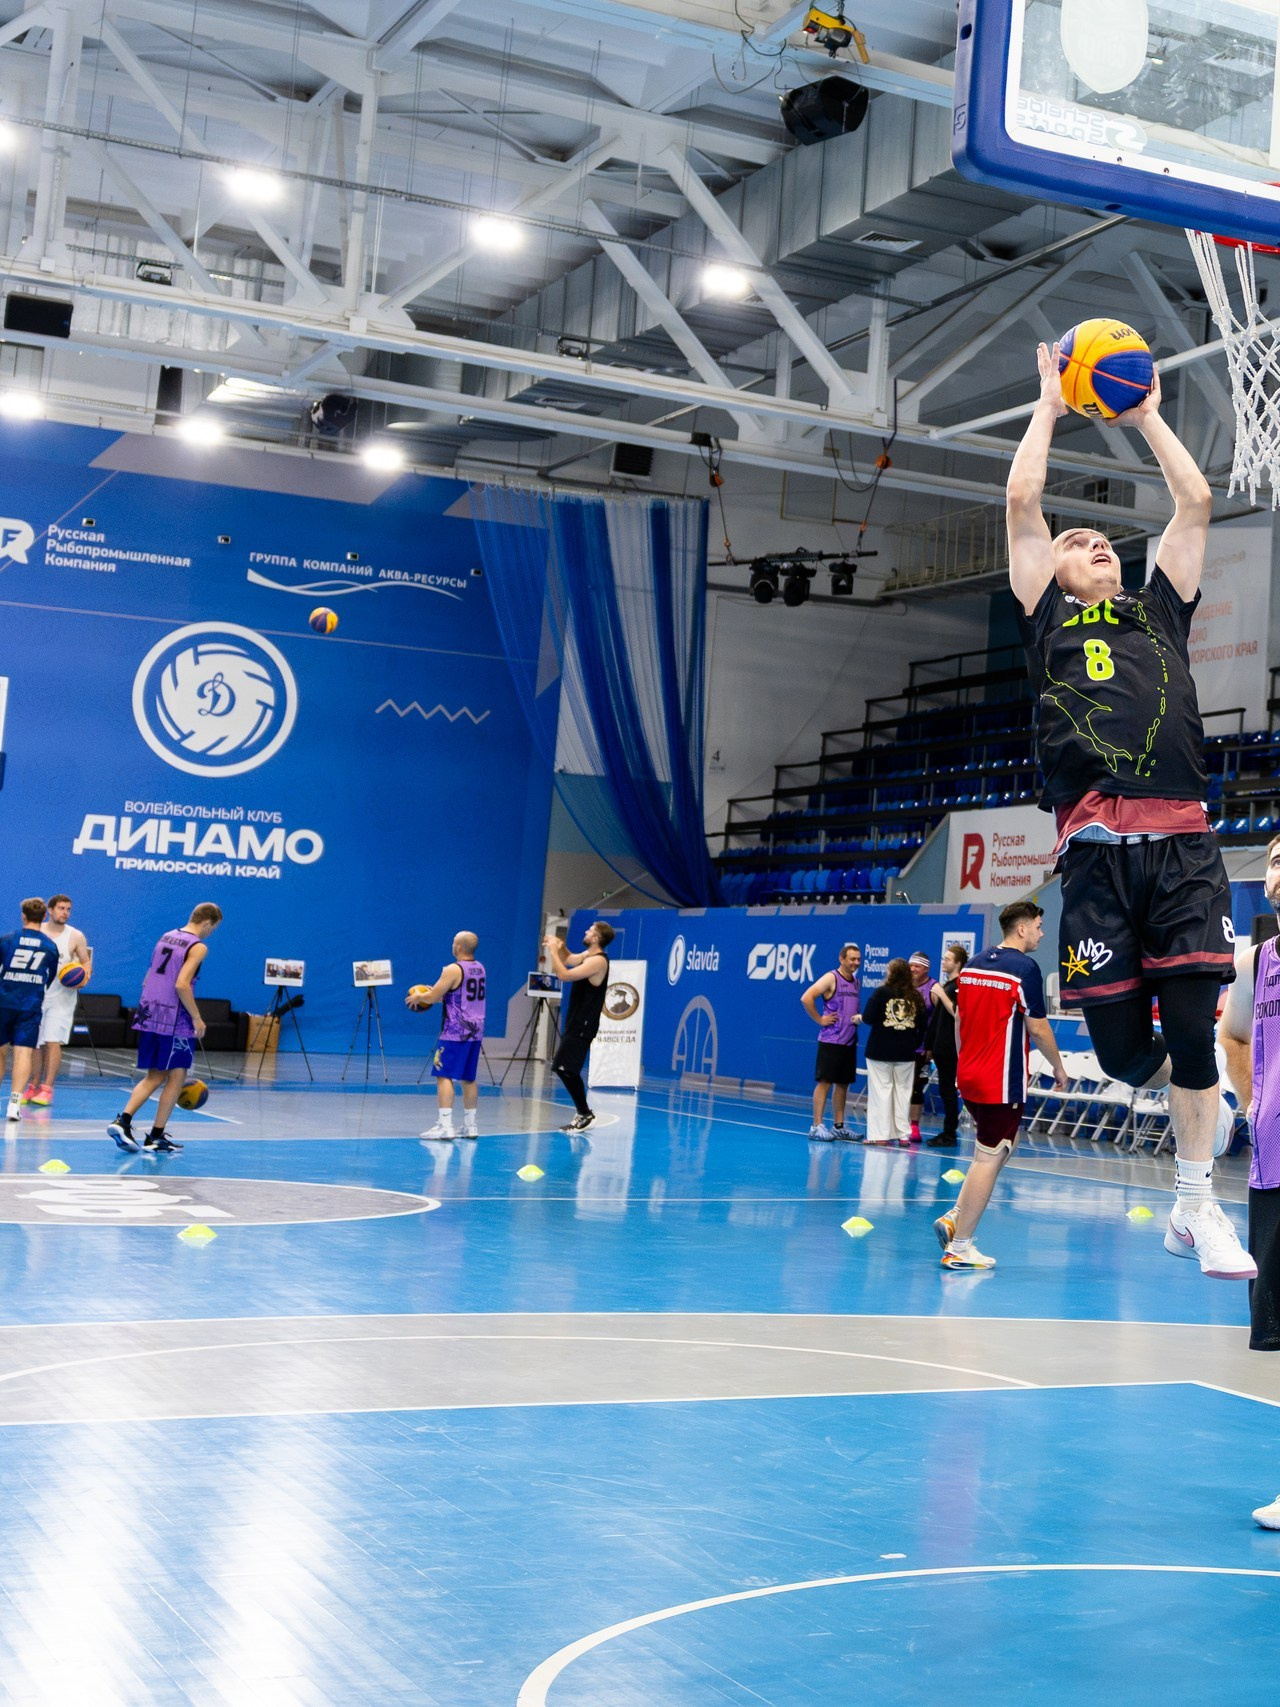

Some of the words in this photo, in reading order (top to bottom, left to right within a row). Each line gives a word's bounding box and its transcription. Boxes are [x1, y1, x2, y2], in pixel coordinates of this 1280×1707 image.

[47, 524, 105, 543] Русская
[44, 553, 116, 573] Компания
[46, 538, 191, 567] Рыбопромышленная
[249, 551, 297, 568] ГРУППА
[302, 558, 373, 577] КОМПАНИЙ
[378, 568, 467, 589] АКВА-РЕСУРСЫ
[1083, 638, 1115, 681] 8
[124, 800, 243, 822] ВОЛЕЙБОЛЬНЫЙ
[247, 809, 282, 824] КЛУБ
[72, 813, 324, 865] ДИНАМО
[992, 832, 1026, 851] Русская
[115, 857, 232, 877] ПРИМОРСКИЙ
[235, 864, 280, 880] КРАЙ
[991, 852, 1057, 870] Рыбопромышле
[990, 872, 1032, 887] Компания
[10, 949, 46, 971] 21
[156, 947, 173, 975] 7
[685, 944, 720, 971] slavda
[774, 943, 817, 984] ВСК
[466, 977, 486, 1002] 96
